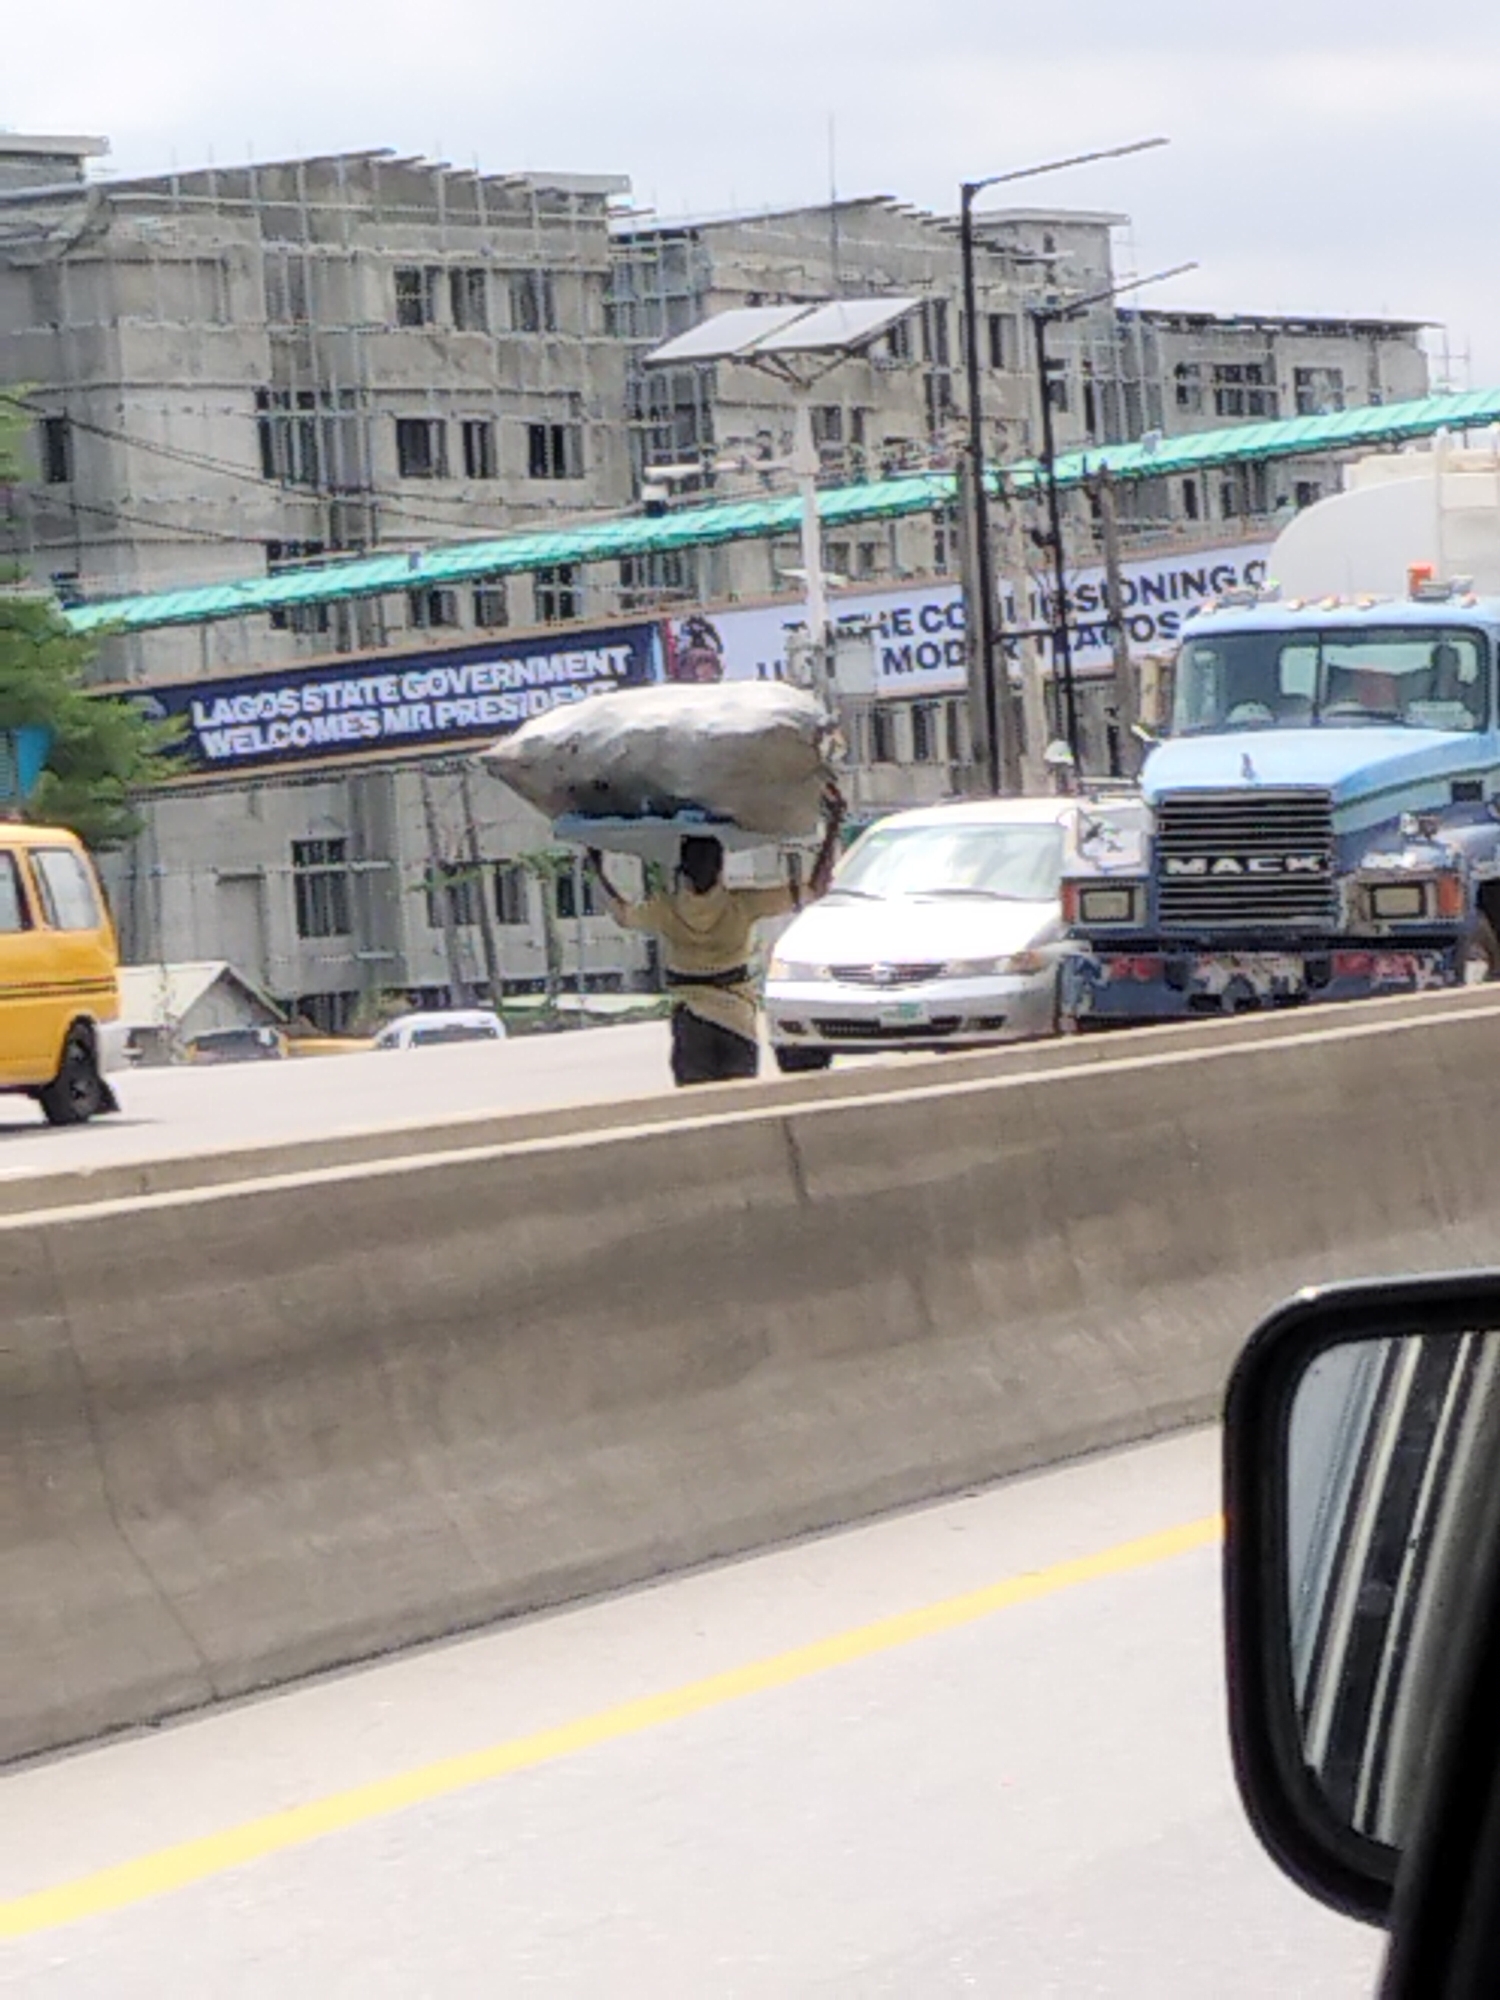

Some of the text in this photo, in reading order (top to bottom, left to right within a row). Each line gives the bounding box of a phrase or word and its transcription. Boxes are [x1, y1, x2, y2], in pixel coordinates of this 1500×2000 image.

[192, 644, 632, 729] LAGOS STATE GOVERNMENT
[201, 709, 380, 759] WELCOMES
[382, 702, 433, 735] MR
[1166, 855, 1323, 875] MACK
